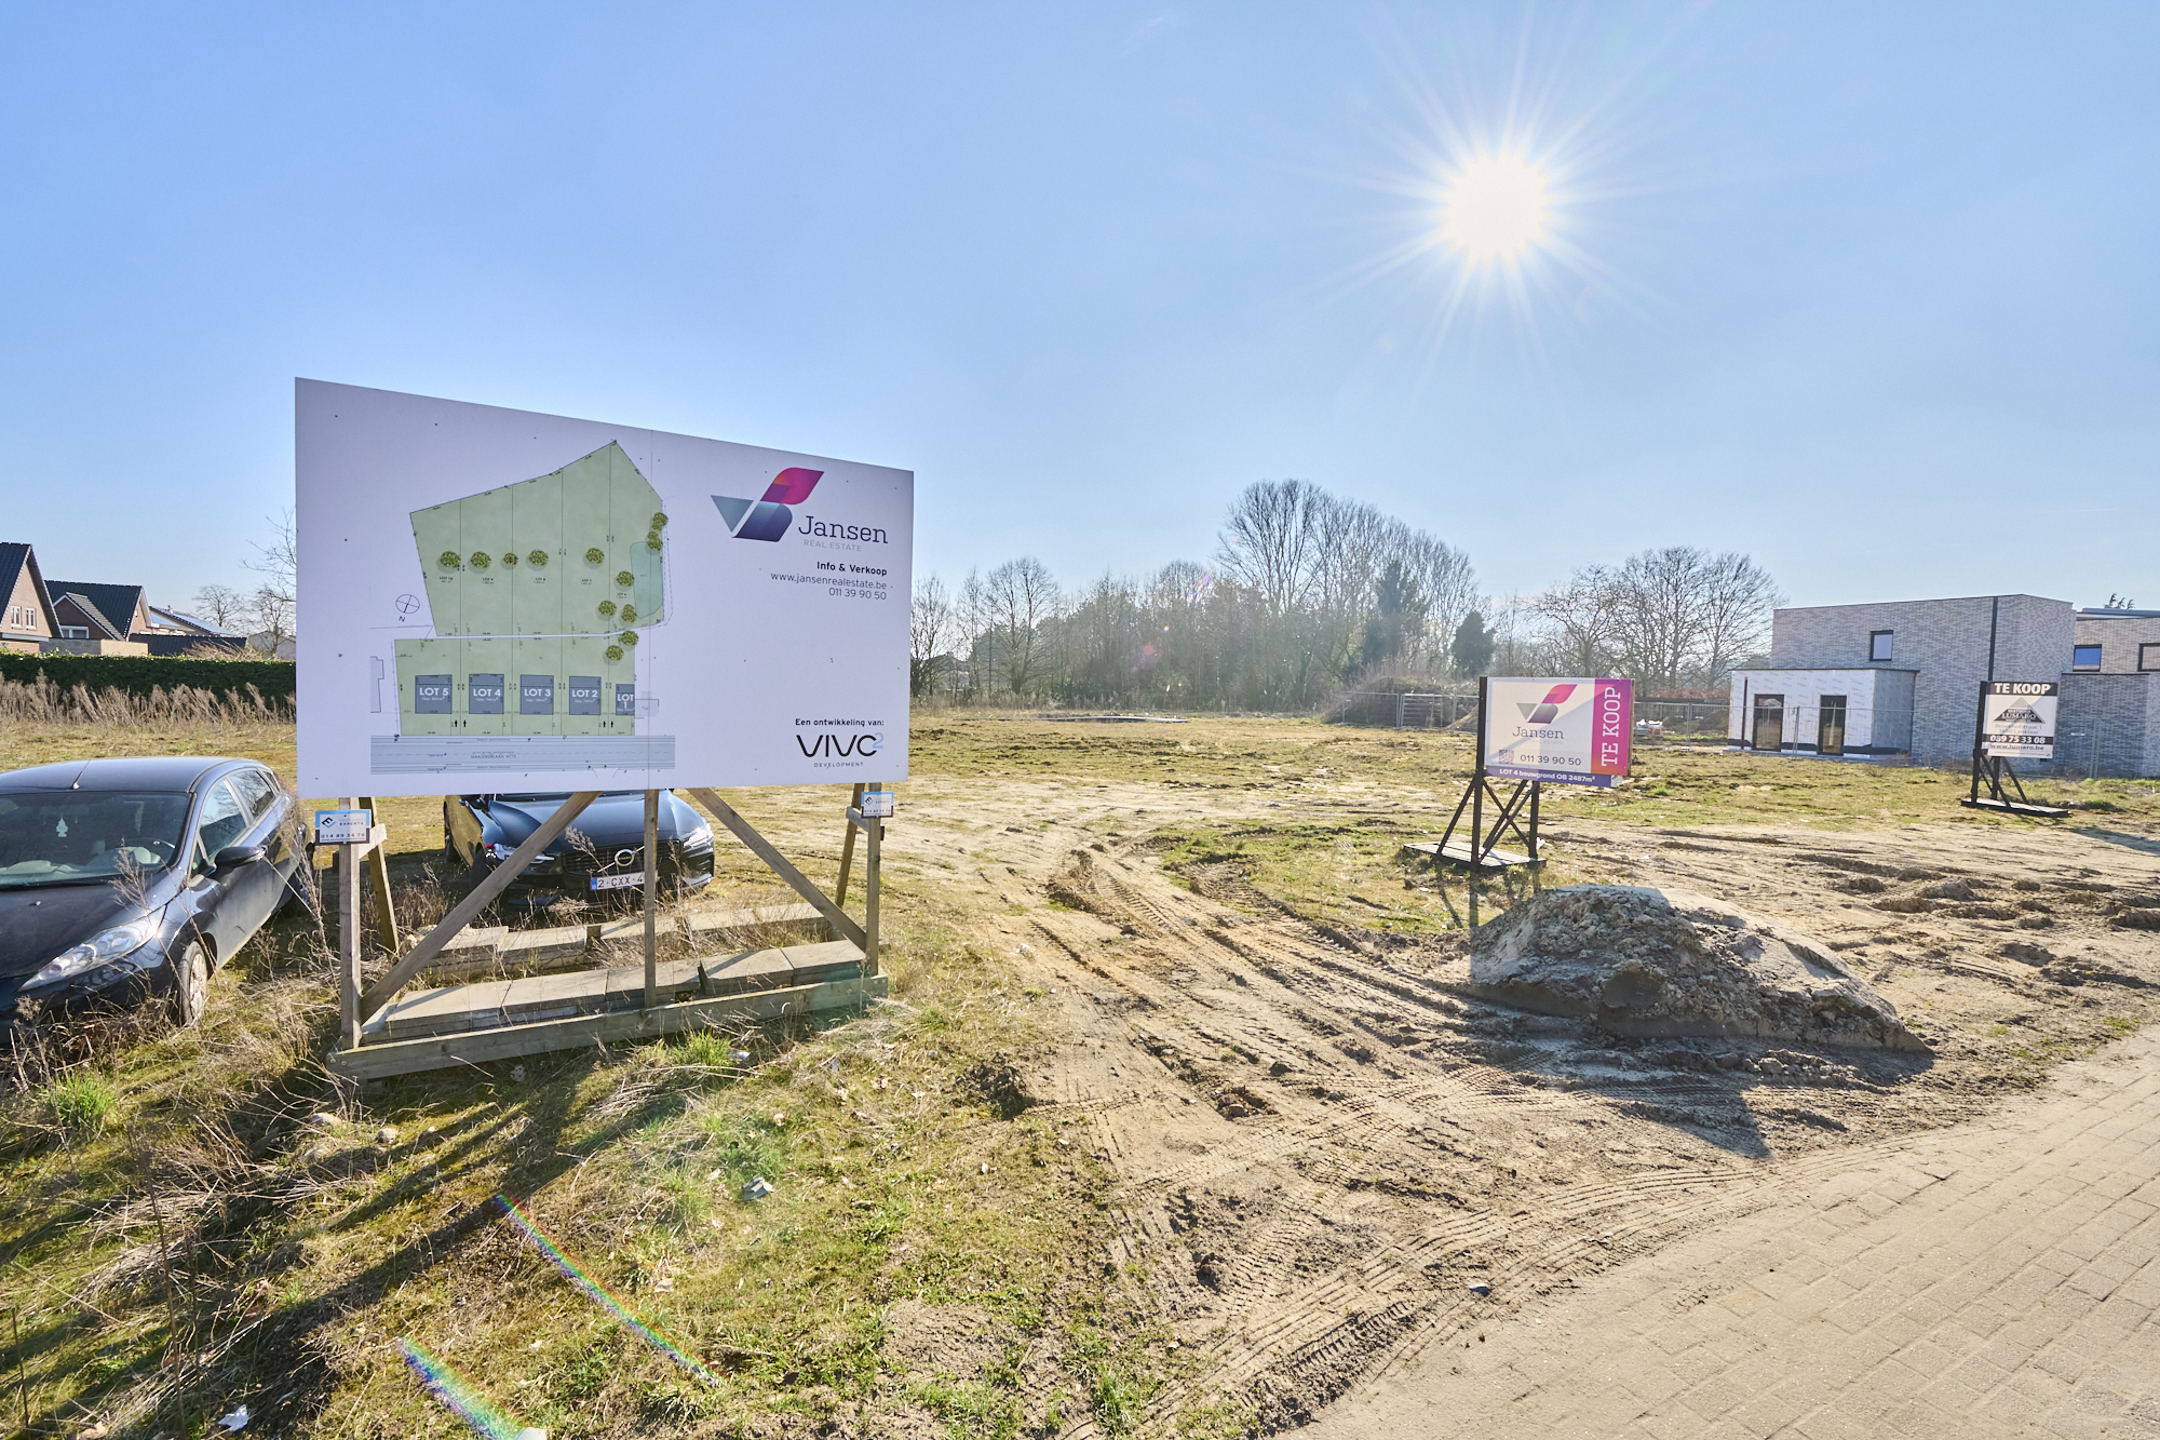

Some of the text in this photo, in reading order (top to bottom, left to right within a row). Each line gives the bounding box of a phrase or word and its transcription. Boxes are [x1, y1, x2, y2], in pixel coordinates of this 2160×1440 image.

[799, 515, 888, 544] Jansen
[804, 539, 862, 552] REAL ESTATE
[817, 561, 888, 577] Info & Verkoop
[770, 573, 887, 590] www.jansenrealestate.be
[828, 587, 887, 600] 011 39 90 50
[419, 687, 449, 697] LOT 5
[472, 688, 501, 697] LOT 4
[524, 688, 551, 697] LOT 3
[571, 689, 598, 698] LOT 2
[1994, 682, 2051, 695] TE KOOP
[617, 693, 634, 702] LOT
[623, 701, 627, 709] 1
[795, 718, 811, 726] Een
[813, 718, 865, 727] ontwikkeling
[1601, 686, 1621, 767] TE KOOP
[1512, 726, 1564, 740] Jansen
[2008, 735, 2020, 743] 75
[1520, 754, 1581, 766] 011 39 90 50
[1519, 769, 1556, 779] bouwgrond
[1556, 772, 1567, 780] OB
